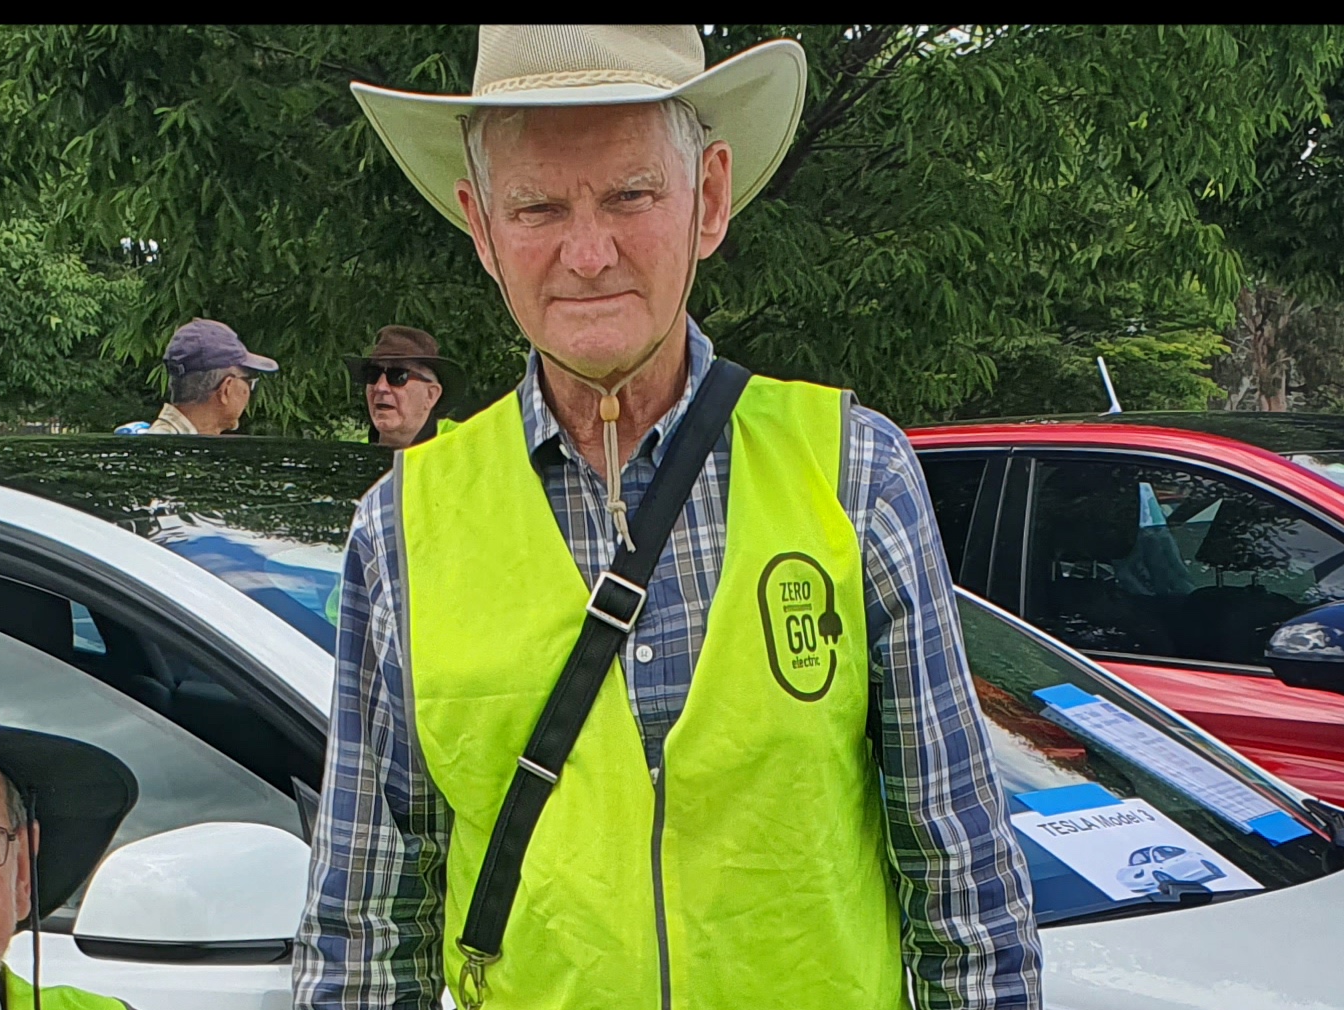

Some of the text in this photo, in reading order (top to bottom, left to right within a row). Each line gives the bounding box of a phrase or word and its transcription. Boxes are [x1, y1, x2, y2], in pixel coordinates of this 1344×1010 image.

[779, 581, 811, 602] ZERO
[786, 614, 817, 654] GO
[792, 656, 821, 669] electric
[1036, 808, 1156, 837] TESLA Model 3
